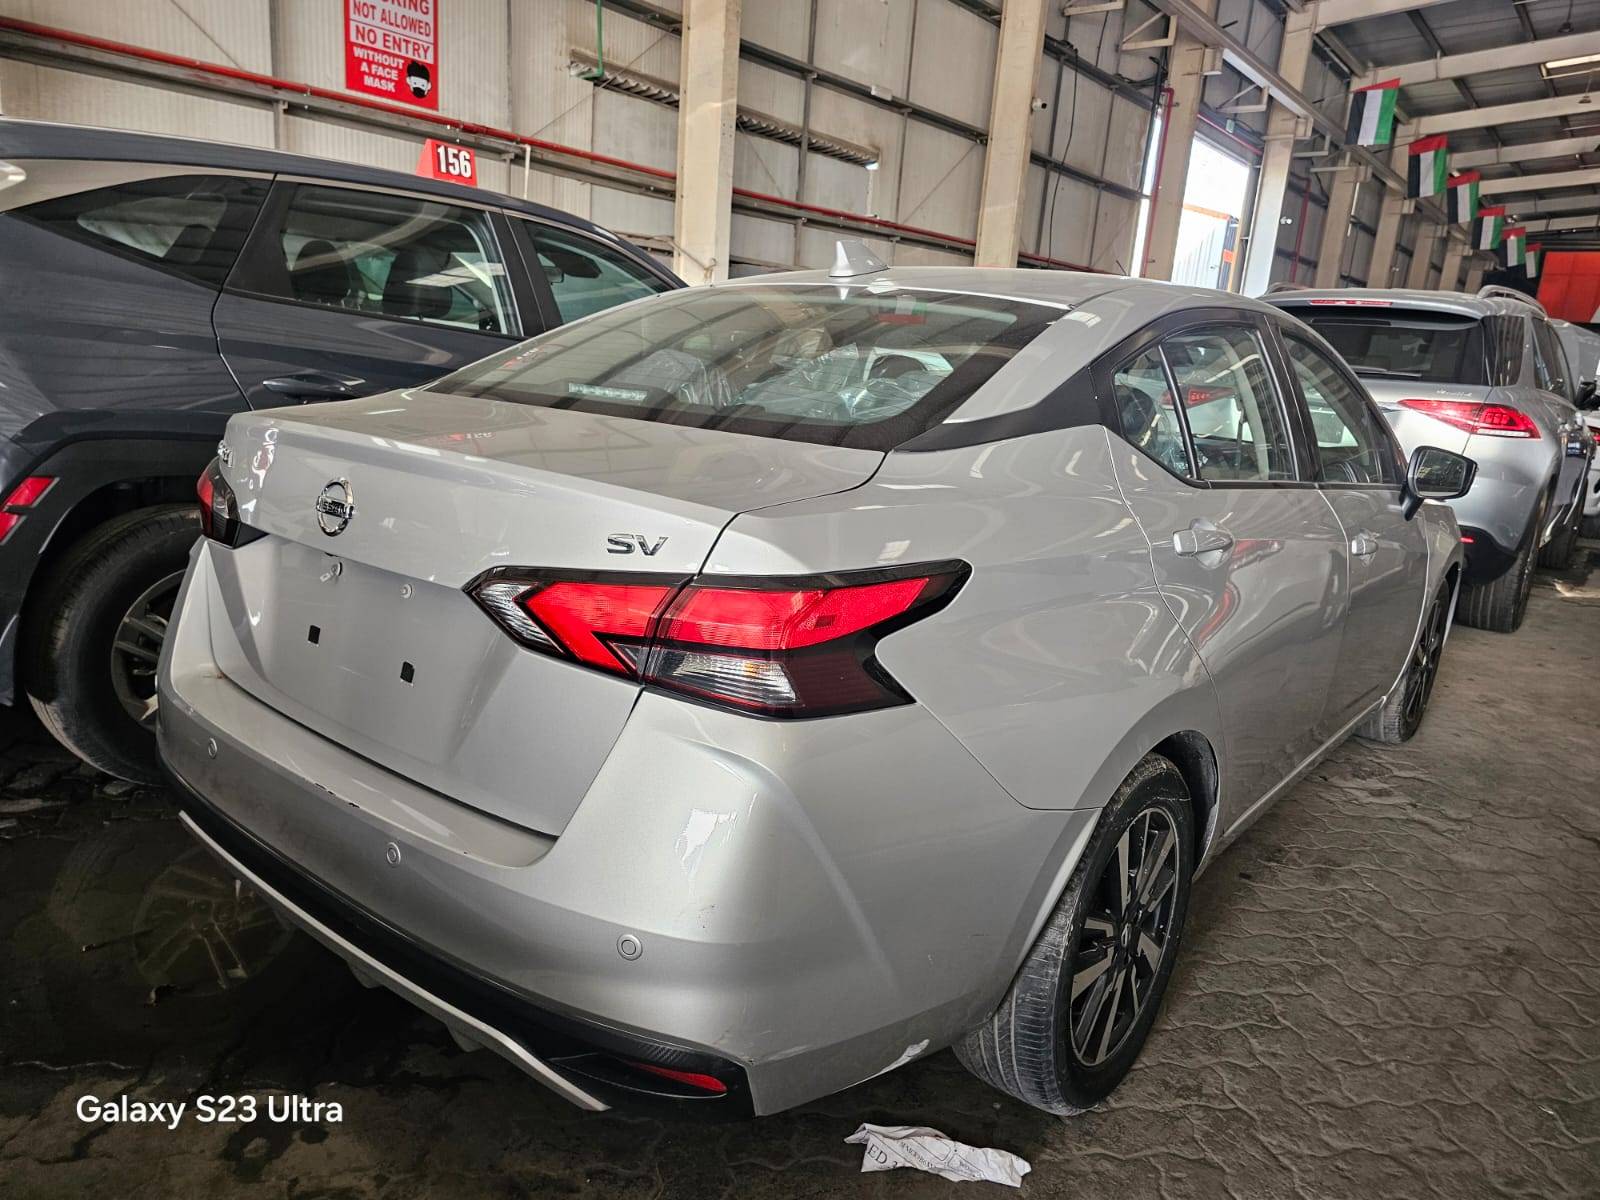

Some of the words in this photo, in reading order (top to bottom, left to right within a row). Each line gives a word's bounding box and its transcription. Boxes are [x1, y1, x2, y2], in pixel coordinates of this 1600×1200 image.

[353, 0, 376, 20] NOT
[381, 8, 431, 37] ALLOWED
[381, 0, 429, 15] ING
[355, 24, 377, 45] NO
[382, 32, 430, 60] ENTRY
[352, 46, 404, 69] WITHOUT
[360, 61, 369, 73] A
[371, 64, 399, 80] FACE
[363, 75, 396, 93] MASK
[437, 144, 472, 178] 156
[607, 533, 669, 556] SV
